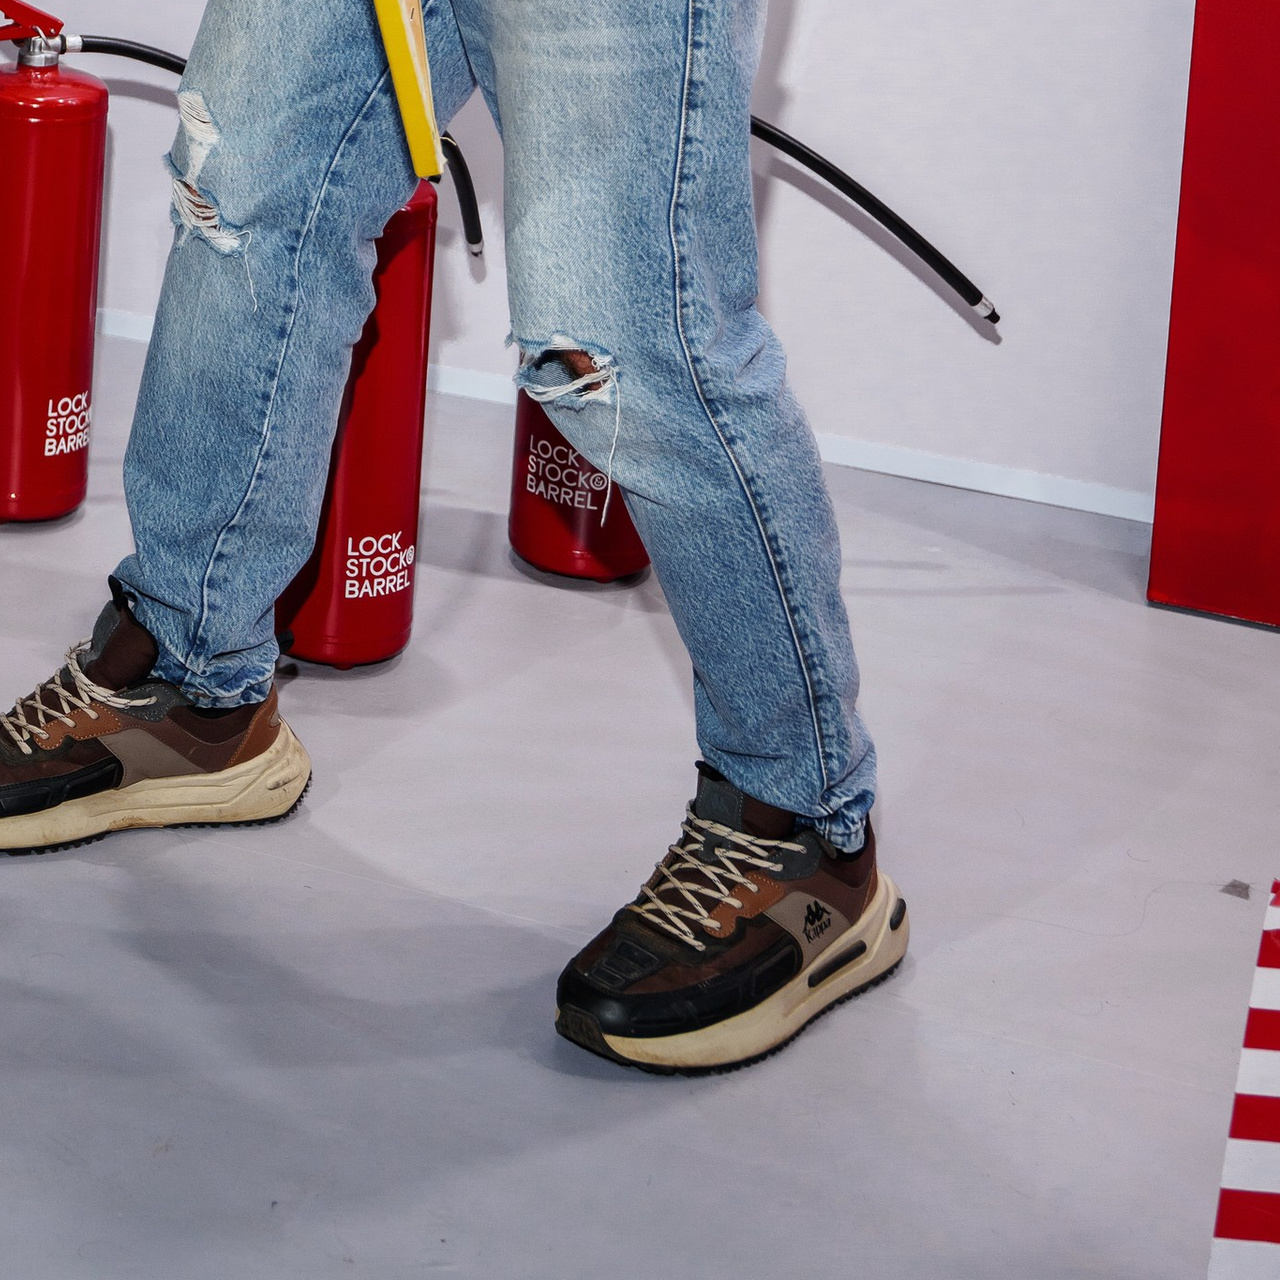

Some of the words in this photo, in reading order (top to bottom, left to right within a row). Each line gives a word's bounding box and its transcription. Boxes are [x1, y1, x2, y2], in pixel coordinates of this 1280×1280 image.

[47, 390, 89, 418] LOCK
[530, 434, 580, 468] LOCK
[526, 473, 598, 510] BARREL
[347, 530, 402, 557] LOCK
[345, 569, 411, 599] BARREL
